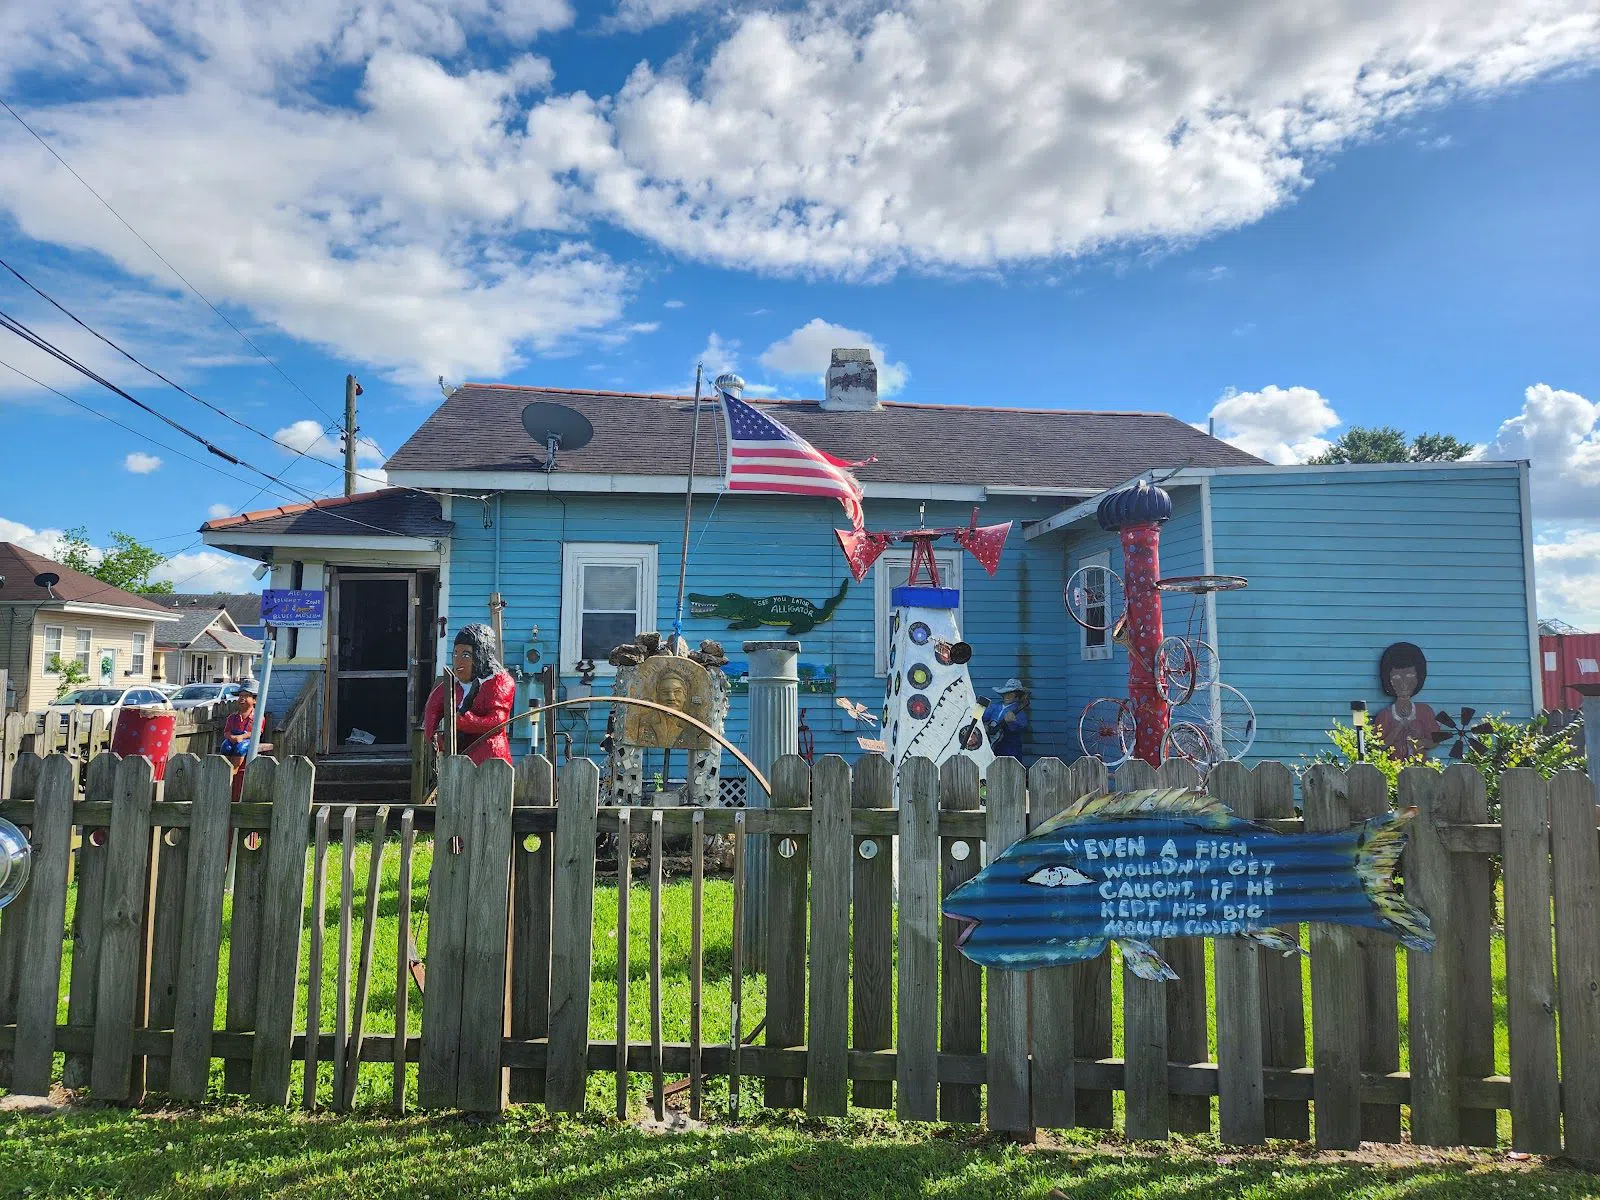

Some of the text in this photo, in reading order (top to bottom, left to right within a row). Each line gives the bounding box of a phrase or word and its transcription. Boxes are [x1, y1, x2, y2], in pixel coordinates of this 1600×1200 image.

[773, 596, 787, 604] YOU
[1160, 839, 1179, 859] A
[1228, 859, 1275, 876] GET
[1099, 880, 1195, 900] CAUGHT,
[1246, 877, 1274, 896] HE
[1101, 900, 1160, 918] KEPT
[1103, 919, 1178, 938] MOUTH
